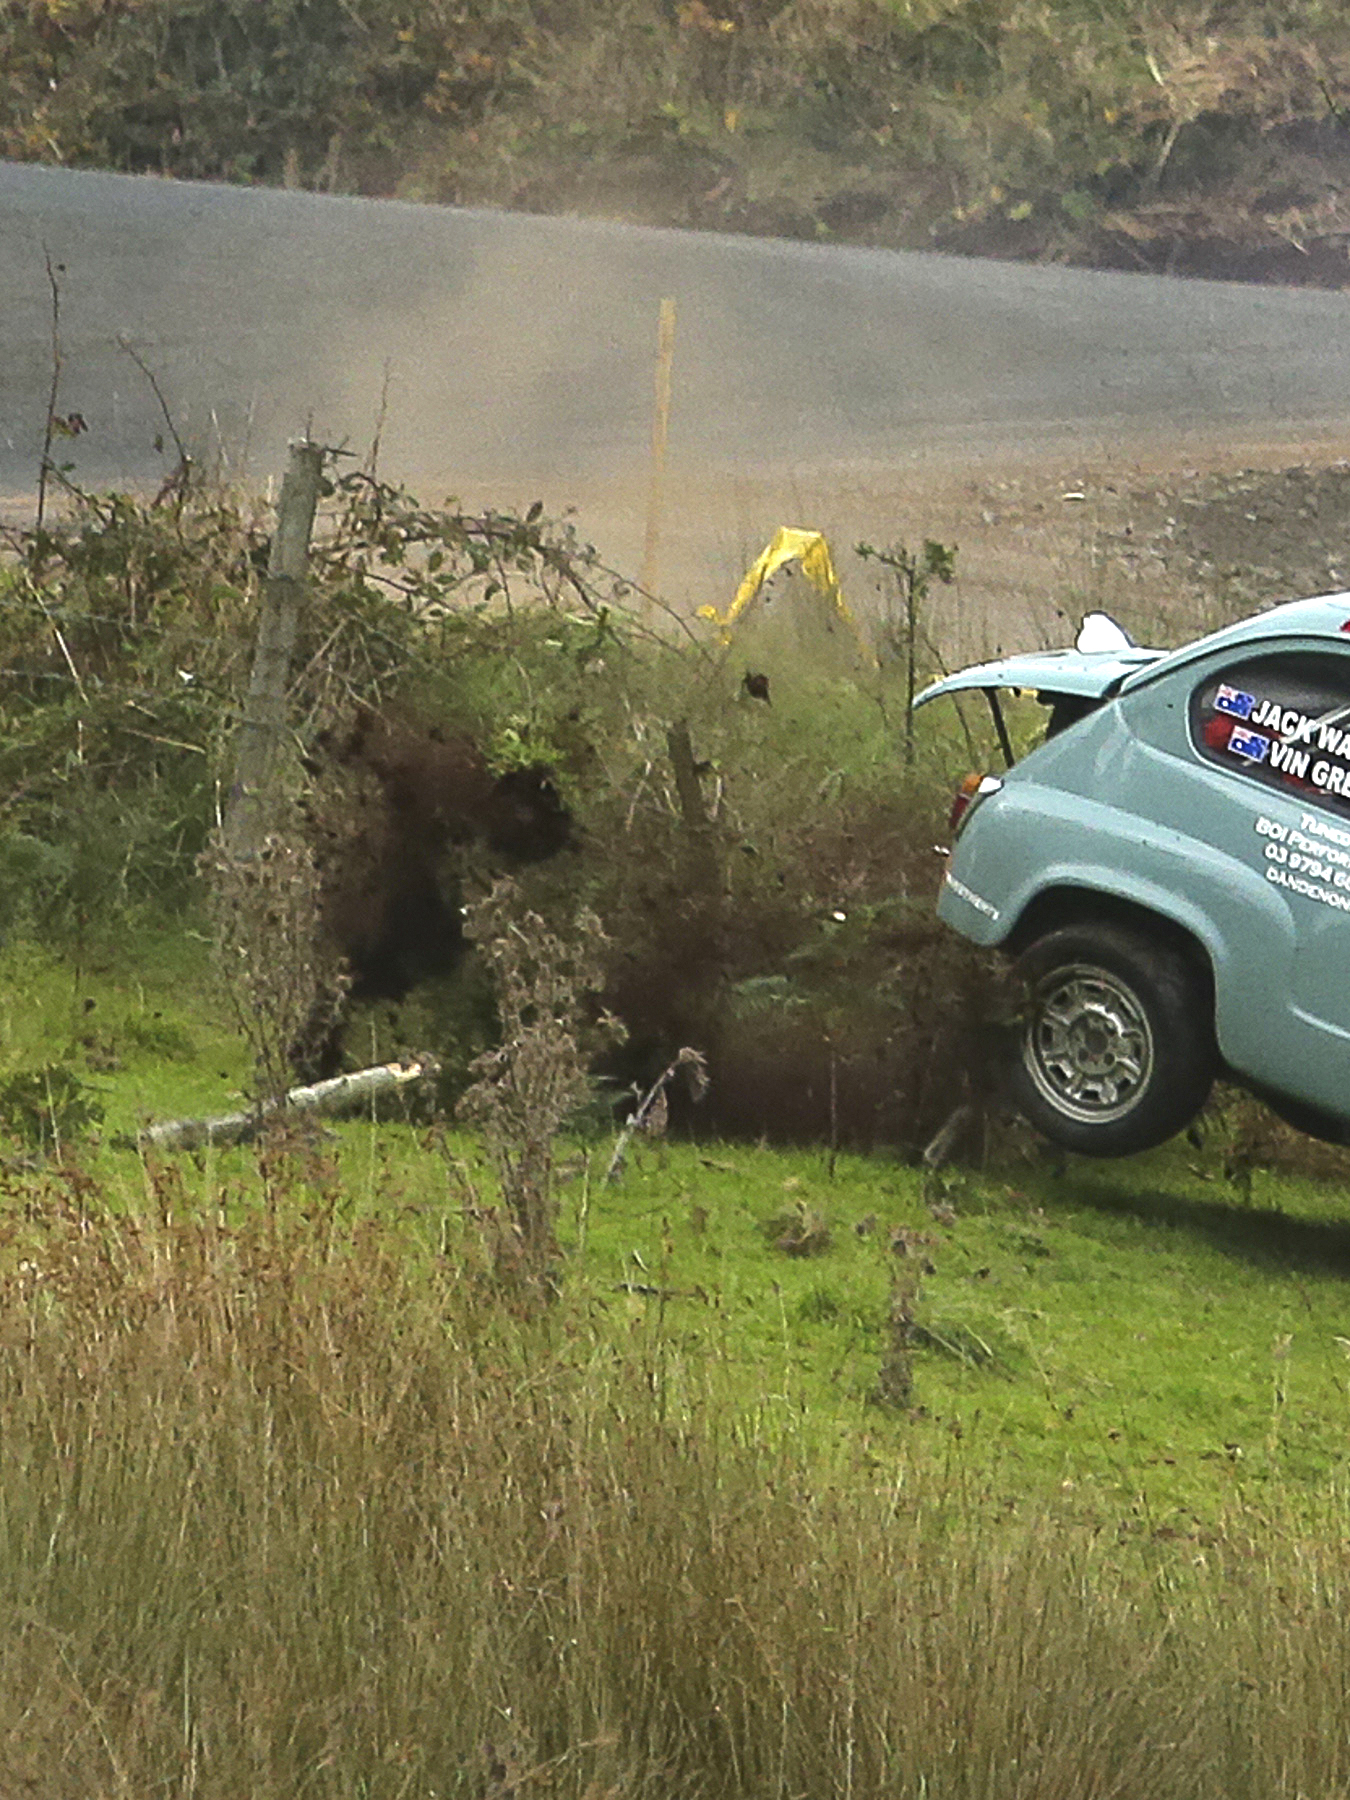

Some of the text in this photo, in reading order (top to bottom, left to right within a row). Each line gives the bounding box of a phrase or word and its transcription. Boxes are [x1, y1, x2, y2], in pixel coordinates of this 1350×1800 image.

[1251, 700, 1318, 744] JACK
[1269, 741, 1311, 778] VIN
[1264, 843, 1288, 864] 03
